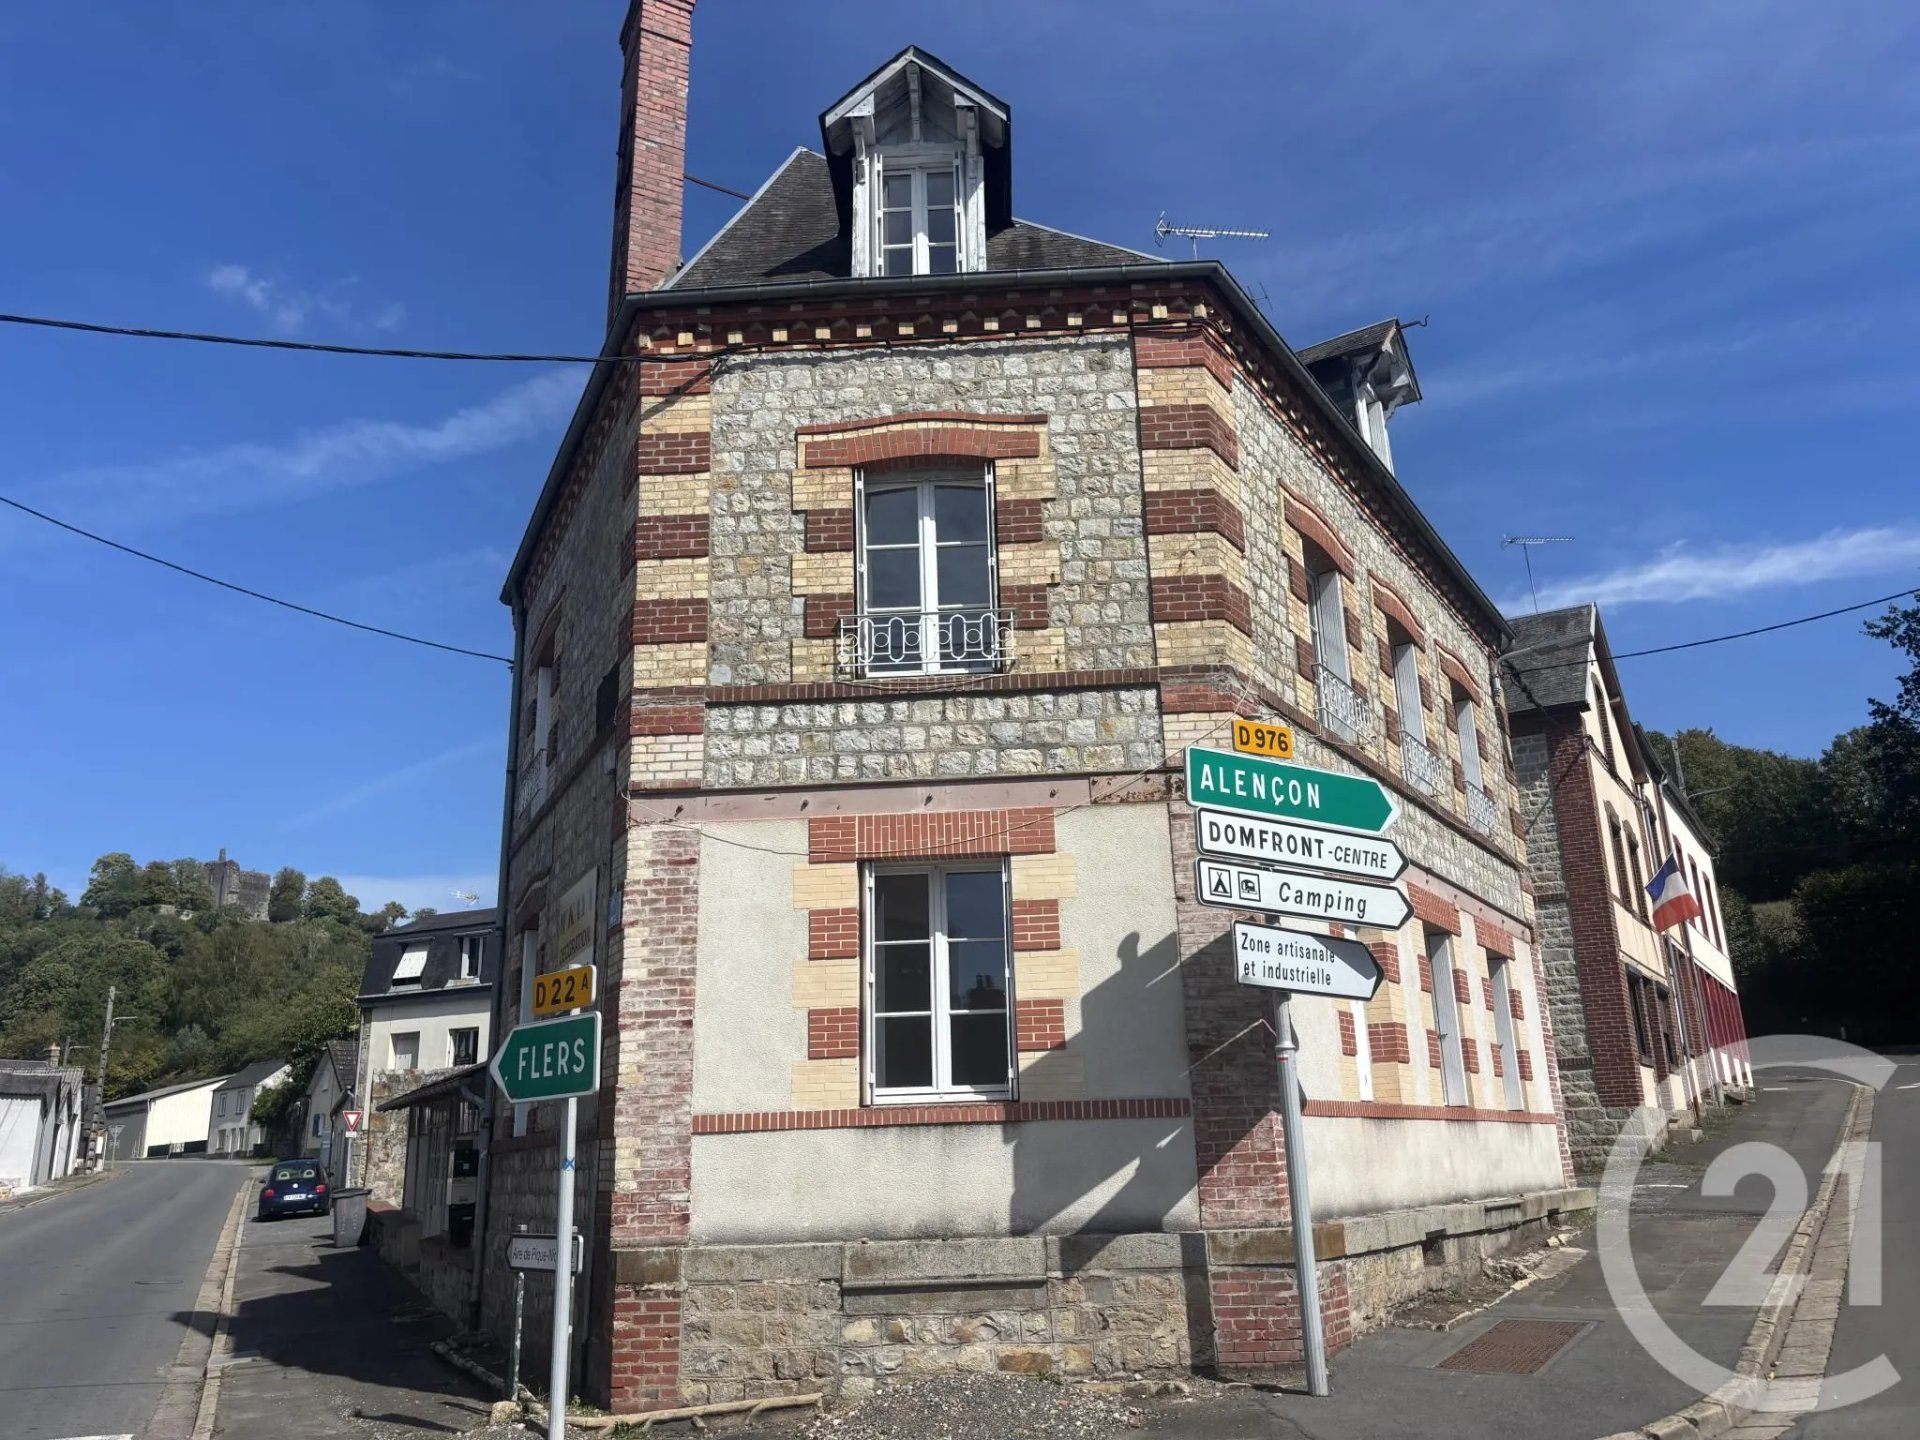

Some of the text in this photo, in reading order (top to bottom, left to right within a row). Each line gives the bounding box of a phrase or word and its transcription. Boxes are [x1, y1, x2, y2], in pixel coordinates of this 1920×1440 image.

[1239, 726, 1288, 752] D 976
[1201, 764, 1320, 809] ALENÇON
[1279, 882, 1368, 918] Camping
[1241, 932, 1335, 963] Zone artisanale
[1243, 961, 1332, 986] et industrielle
[518, 1038, 585, 1081] FLERS
[523, 1247, 532, 1261] de
